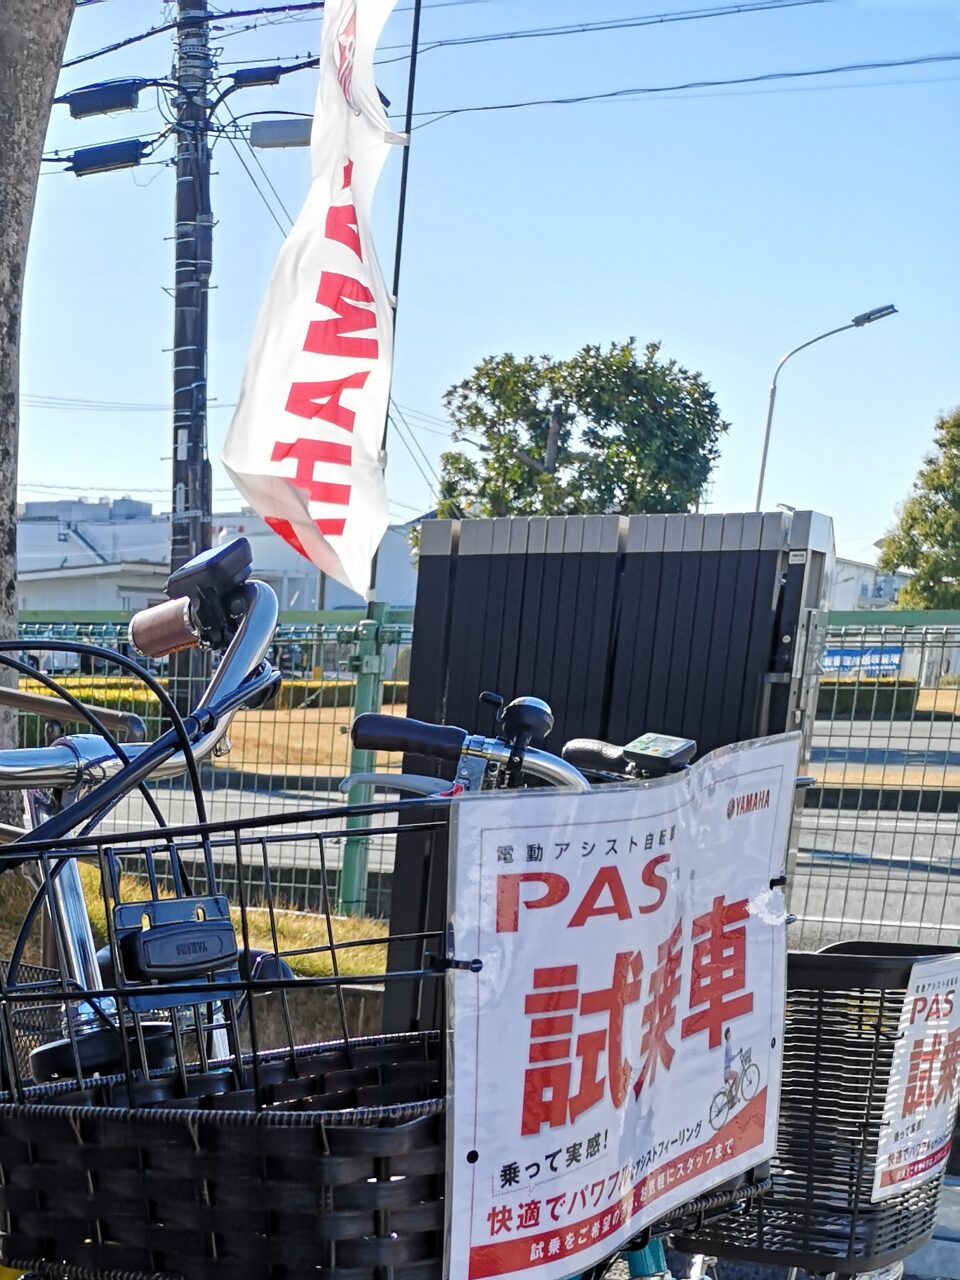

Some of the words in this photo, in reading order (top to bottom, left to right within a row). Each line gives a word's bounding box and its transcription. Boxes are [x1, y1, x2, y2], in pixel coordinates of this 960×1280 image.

[735, 789, 771, 817] YAMAHA
[495, 853, 672, 934] PAS
[520, 894, 755, 1137] 試乗車
[909, 989, 956, 1026] PAS
